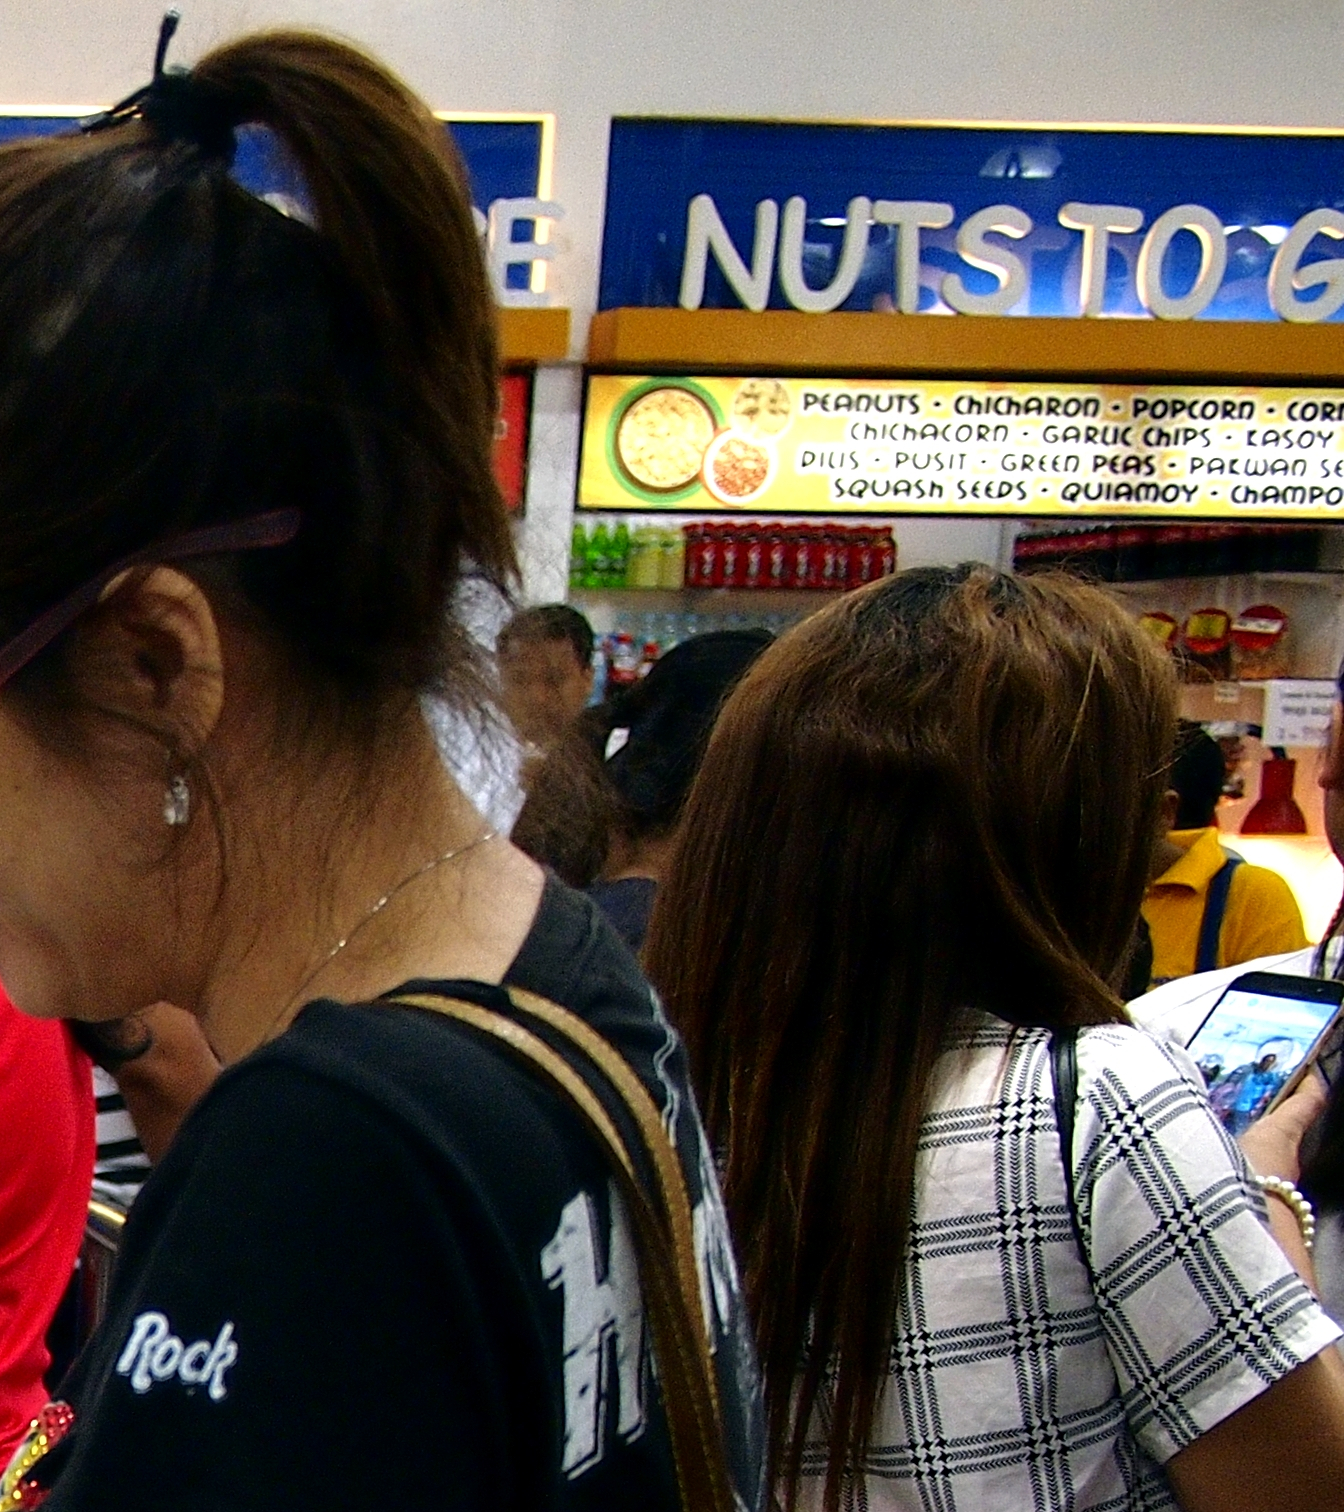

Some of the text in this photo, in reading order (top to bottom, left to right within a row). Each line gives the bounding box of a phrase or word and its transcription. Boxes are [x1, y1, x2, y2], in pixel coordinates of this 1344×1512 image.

[679, 194, 1032, 316] NUTS
[1058, 202, 1227, 321] TO
[1269, 208, 1344, 323] G
[803, 393, 920, 415] PEANUTS
[1132, 398, 1255, 420] POPCORN
[1043, 425, 1132, 447] GARLIC
[1247, 429, 1334, 449] KASOY
[802, 451, 1307, 477] DILIS PUSIT GREEN PEAS PAKWAN
[834, 478, 1344, 505] SQUASH SEEDS QUIAMOY CHAMPO
[117, 1310, 239, 1402] Rock
